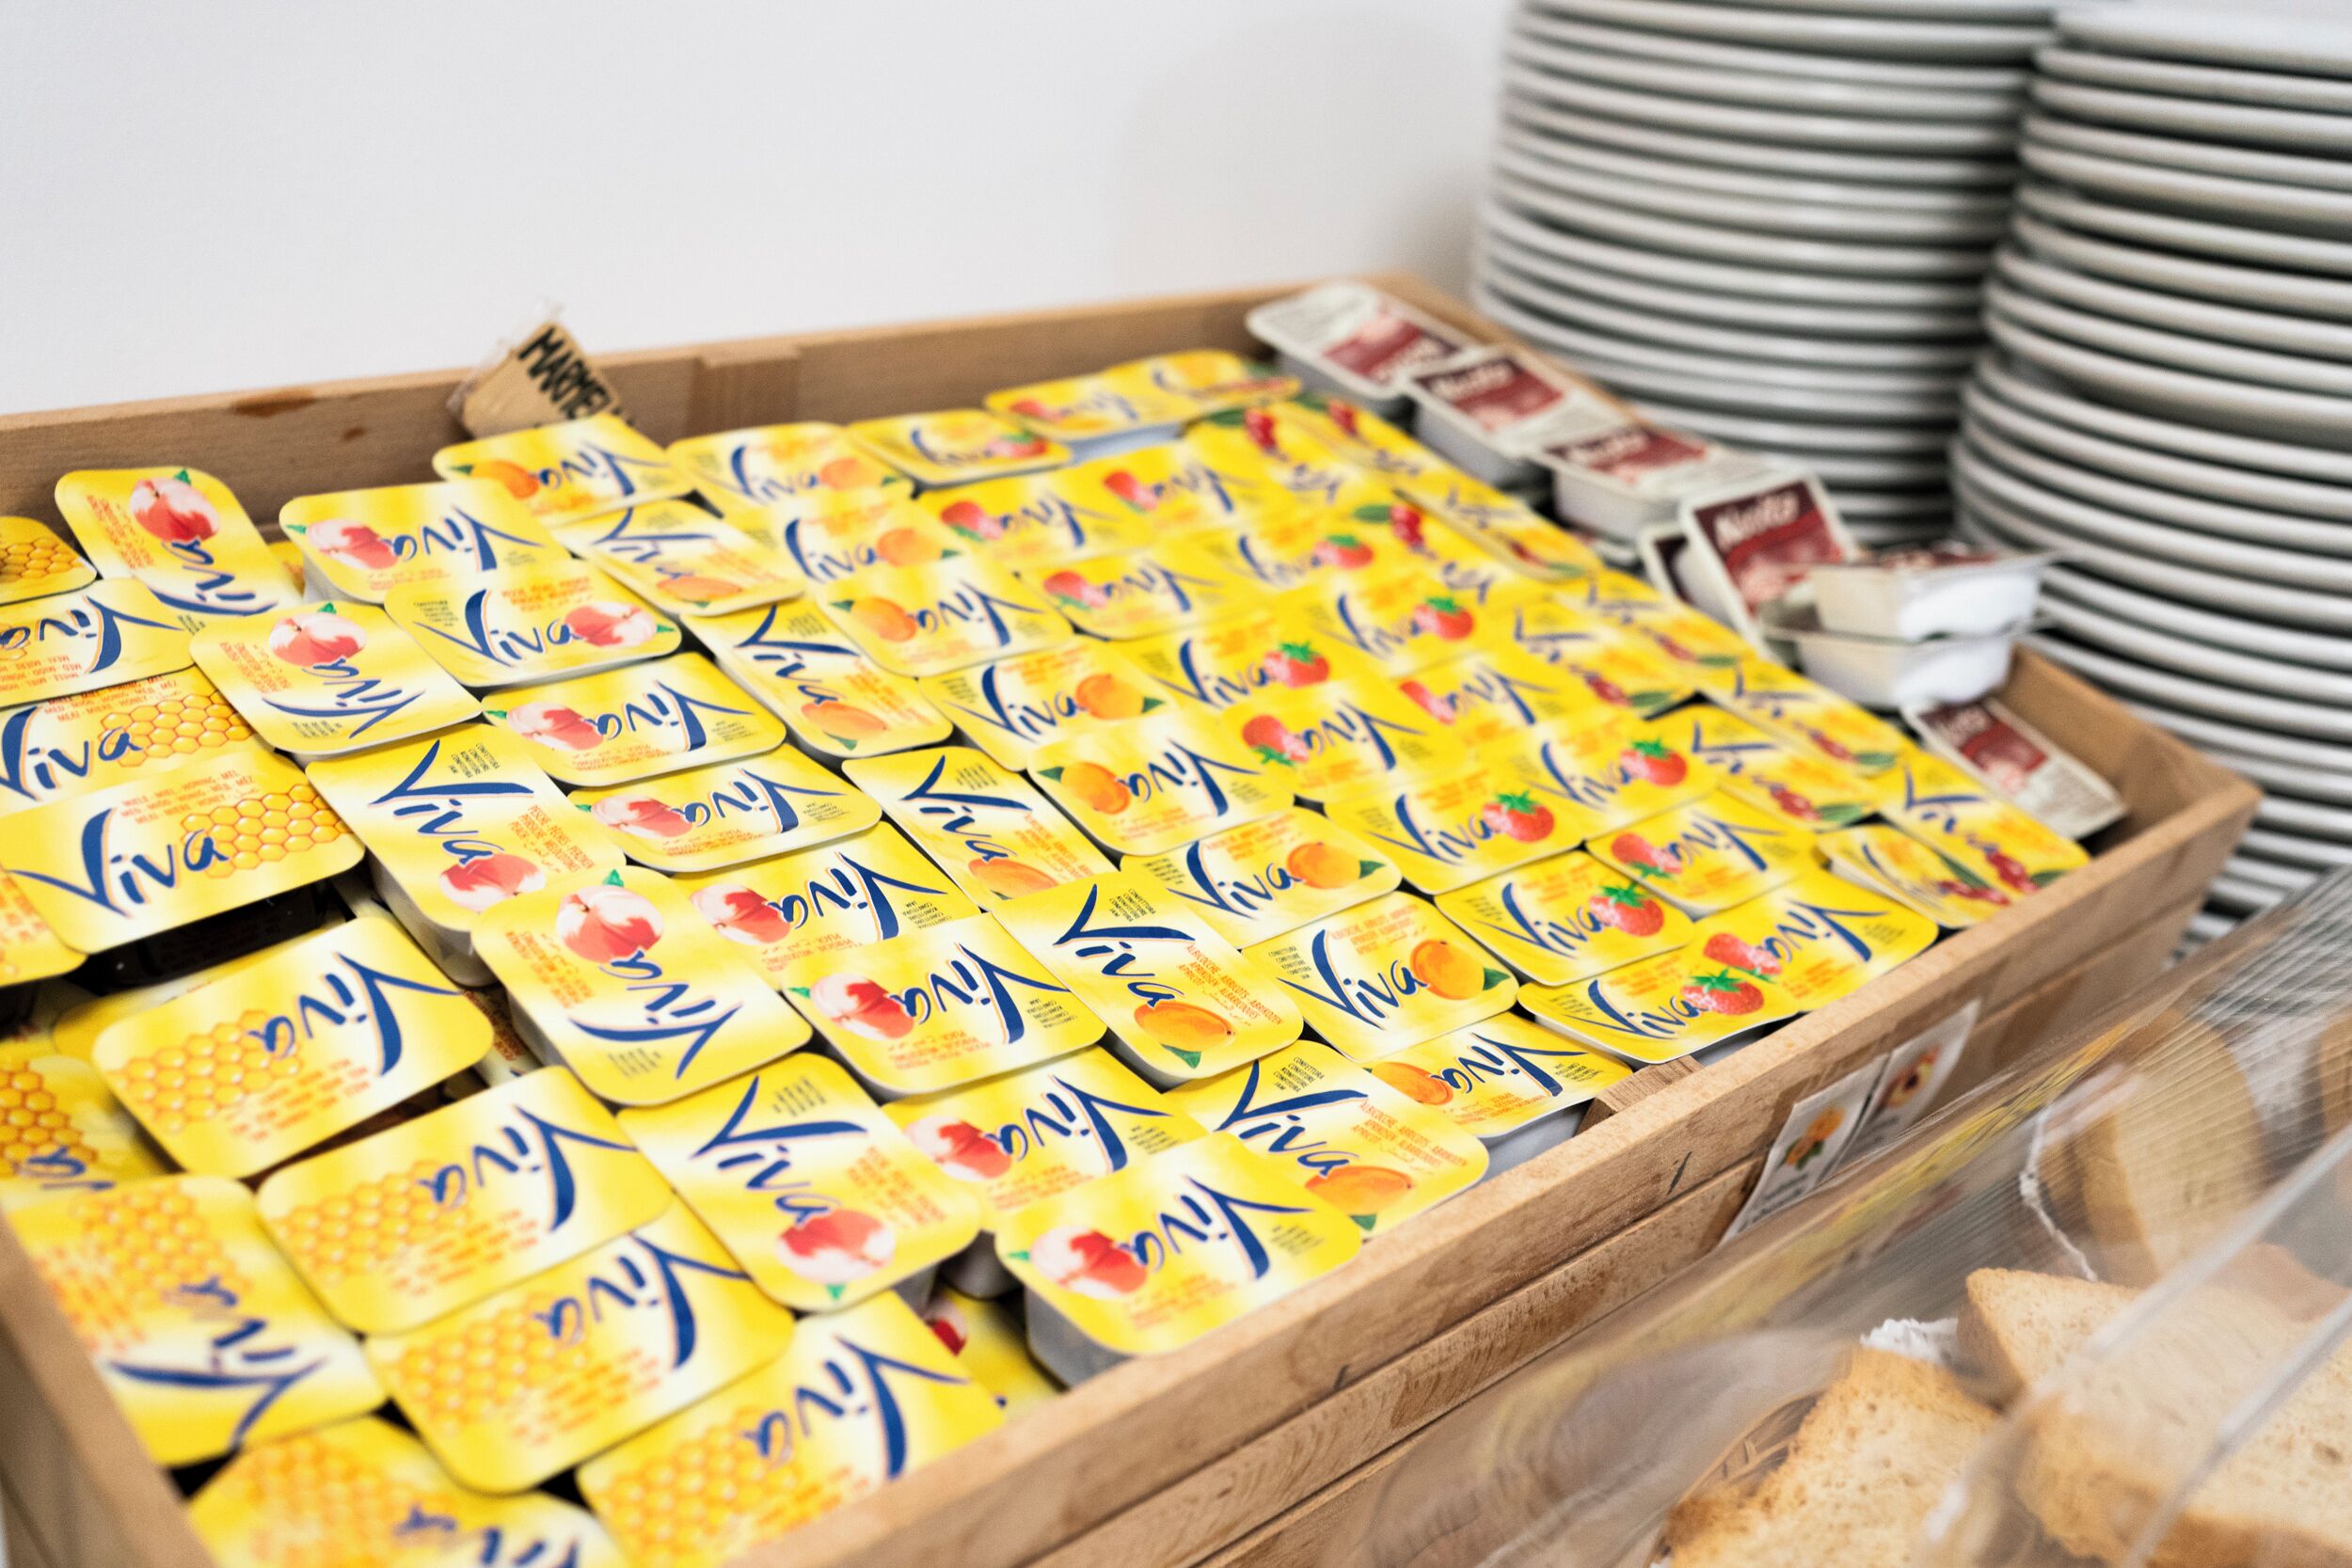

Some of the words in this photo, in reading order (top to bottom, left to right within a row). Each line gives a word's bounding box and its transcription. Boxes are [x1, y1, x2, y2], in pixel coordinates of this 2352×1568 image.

[517, 325, 636, 429] MARMEL
[537, 440, 674, 497] Viva
[150, 538, 279, 618] Viva
[383, 507, 546, 572] Viva
[415, 589, 584, 668] Viva
[916, 579, 1047, 647] Viva
[733, 604, 861, 705] Viva
[1144, 638, 1270, 709] Viva
[261, 658, 427, 739] Viva
[584, 678, 755, 752] Viva
[942, 664, 1089, 743] Viva
[1295, 699, 1428, 771] Viva
[0, 705, 144, 801] Viva
[1115, 737, 1263, 817] Viva
[368, 738, 535, 865] Viva
[670, 768, 847, 833] Viva
[898, 754, 1032, 863] Viva
[1369, 792, 1502, 866] Viva
[7, 807, 230, 918] Viva
[1167, 839, 1308, 921] Viva
[1662, 813, 1788, 872] Viva
[765, 850, 948, 941] Viva
[1128, 888, 1156, 914] CONFETTURA
[1473, 881, 1610, 959] Viva
[1758, 897, 1890, 963] Viva
[1053, 882, 1196, 1007] Viva
[1177, 964, 1204, 986] APRICOT
[1187, 944, 1221, 974] ALBICOCCHE
[1220, 974, 1249, 999] ABRICOTS
[1249, 999, 1284, 1025] ABRIKOZEN
[1278, 927, 1430, 1032] Viva
[249, 951, 466, 1077] Viva
[567, 949, 744, 1081] Viva
[888, 942, 1071, 1044] Viva
[1189, 961, 1219, 987] APRIKOSEN
[1219, 988, 1261, 1019] ALBARICOQUES
[1561, 978, 1713, 1040] Viva
[1275, 1082, 1286, 1090] JAM
[1288, 1063, 1316, 1083] CONFITURE
[1293, 1056, 1325, 1079] CONFETTURA
[1431, 1032, 1589, 1098] Viva
[690, 1075, 870, 1226] Viva
[985, 1074, 1173, 1173] Viva
[1214, 1058, 1369, 1178] Viva
[416, 1104, 641, 1234] Viva
[1114, 1175, 1313, 1280] Viva
[531, 1231, 755, 1370] Viva
[741, 1334, 971, 1481] Viva
